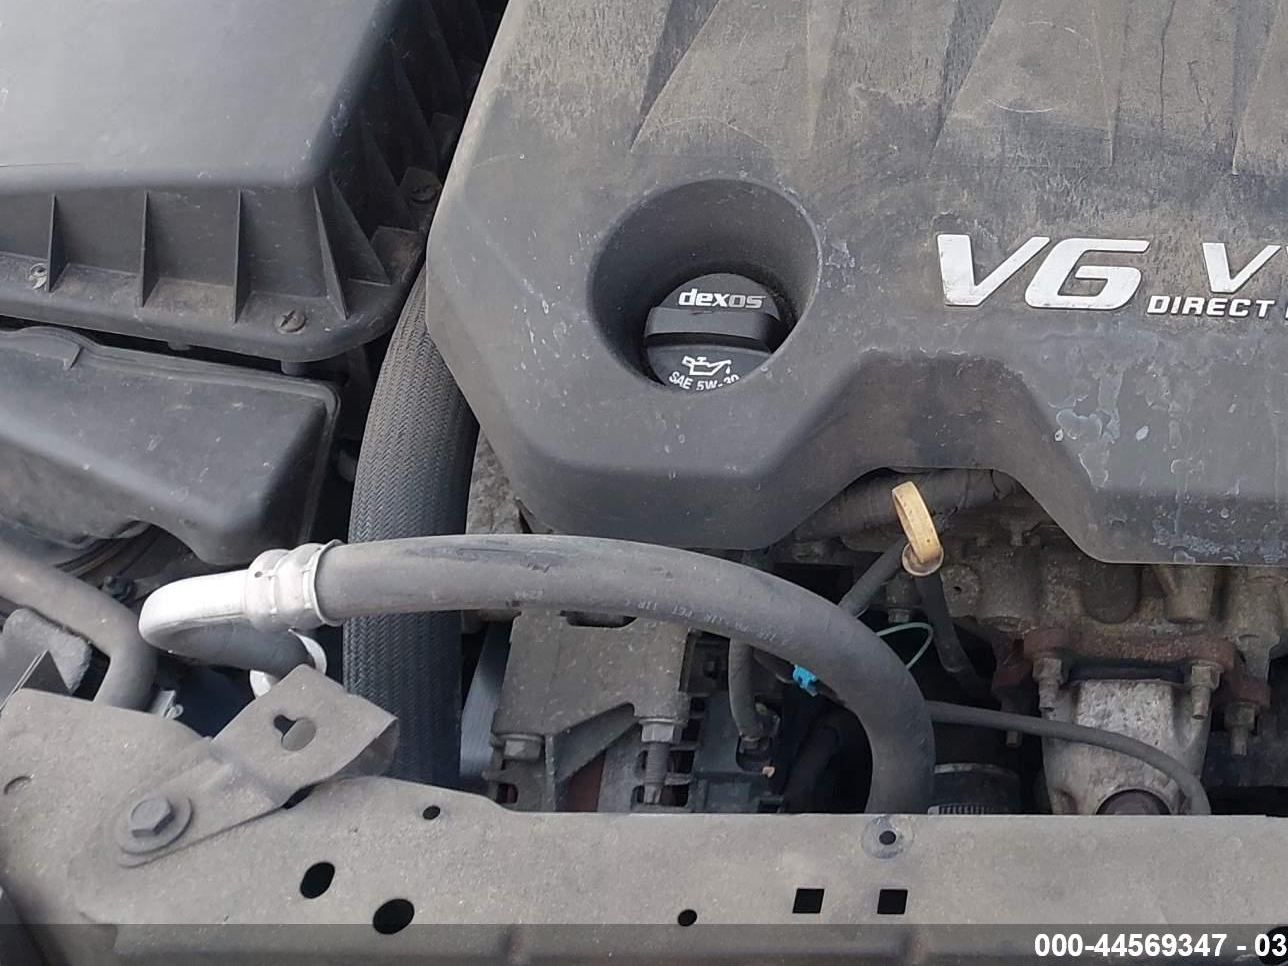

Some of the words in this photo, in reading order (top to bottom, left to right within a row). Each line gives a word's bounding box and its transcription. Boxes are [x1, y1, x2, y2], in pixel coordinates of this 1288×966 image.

[937, 234, 1150, 310] V6
[678, 288, 766, 309] dexos
[1145, 294, 1275, 319] DIRECT
[668, 371, 693, 390] SAE
